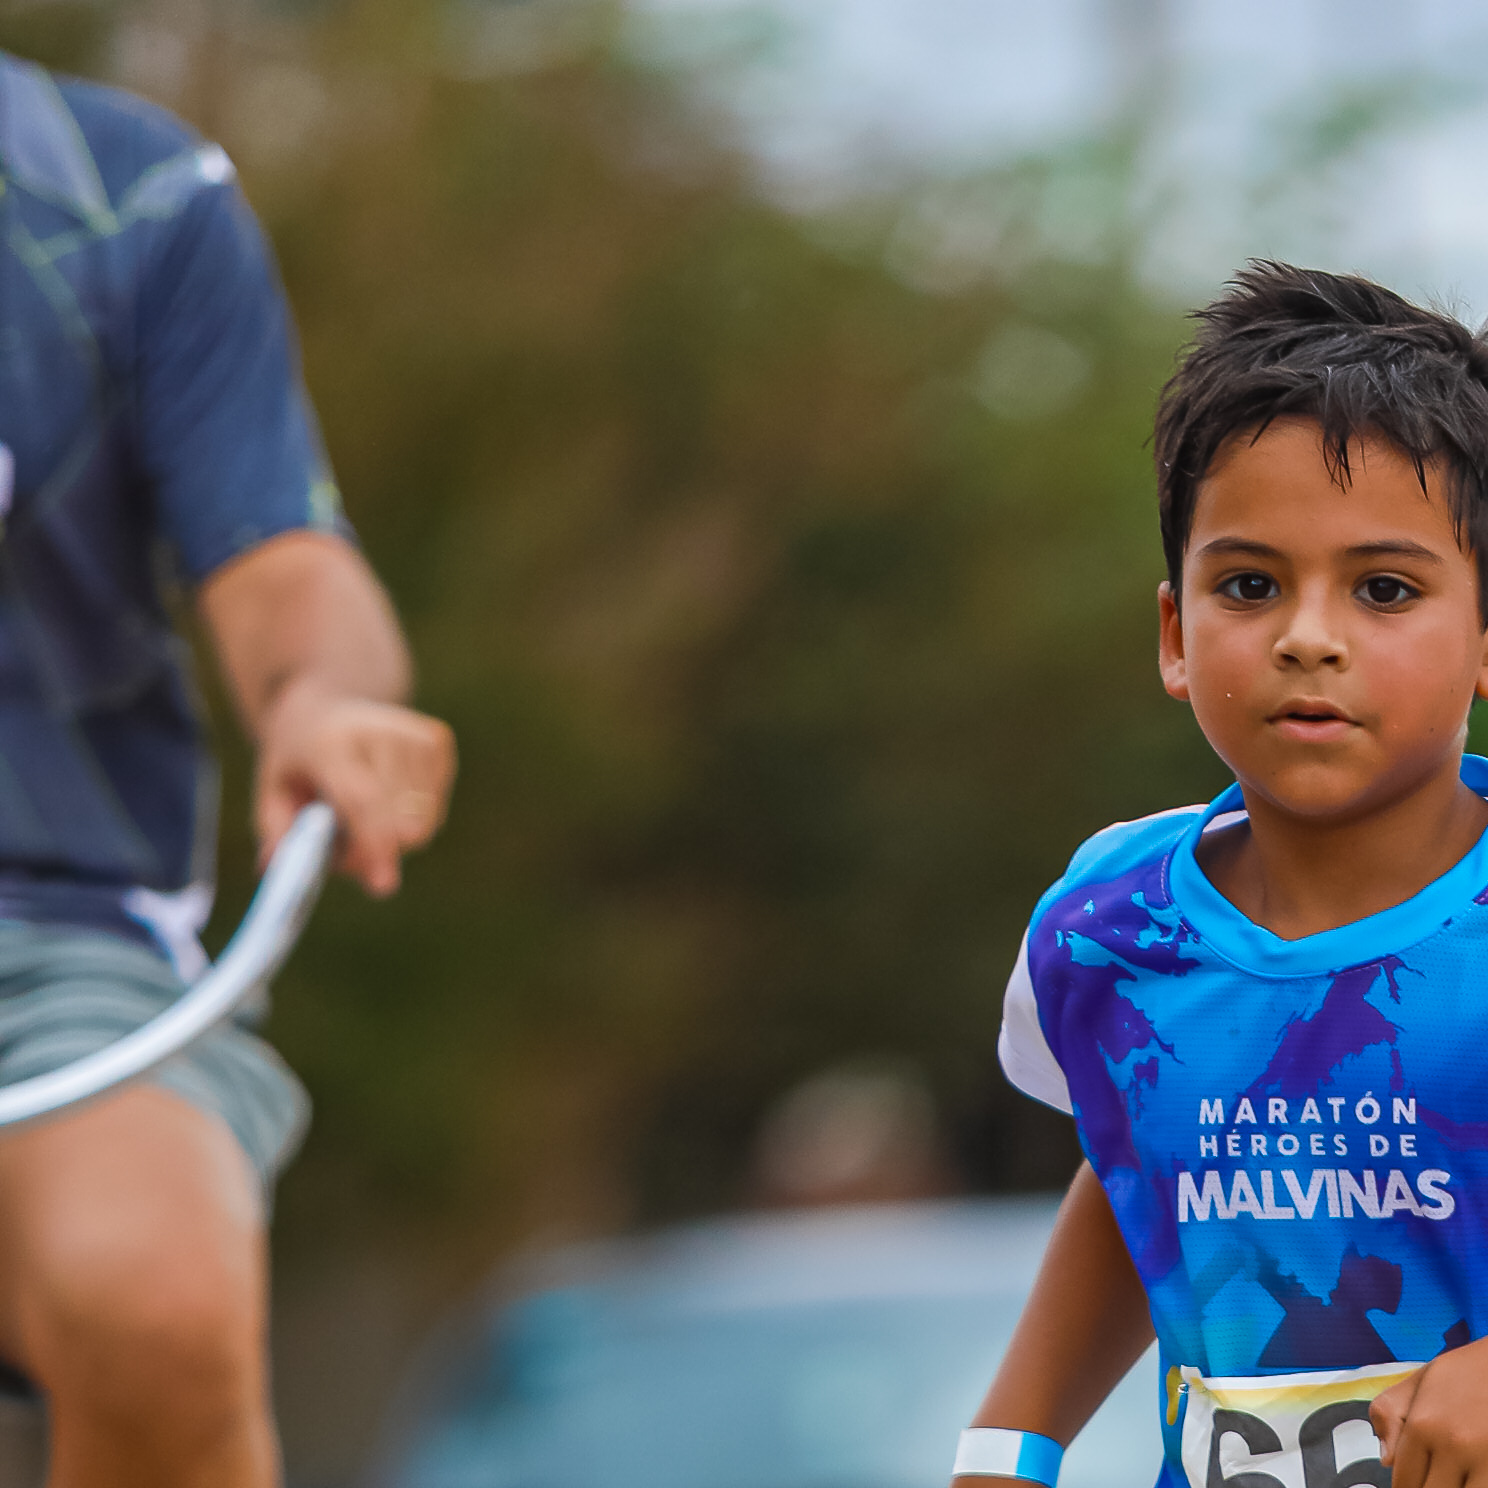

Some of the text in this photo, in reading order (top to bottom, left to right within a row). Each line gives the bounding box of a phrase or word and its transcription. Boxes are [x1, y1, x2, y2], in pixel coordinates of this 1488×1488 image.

[1198, 1091, 1417, 1125] MARATÓN
[1199, 1129, 1418, 1157] HÉROES DE
[1177, 1168, 1456, 1223] MALVINAS
